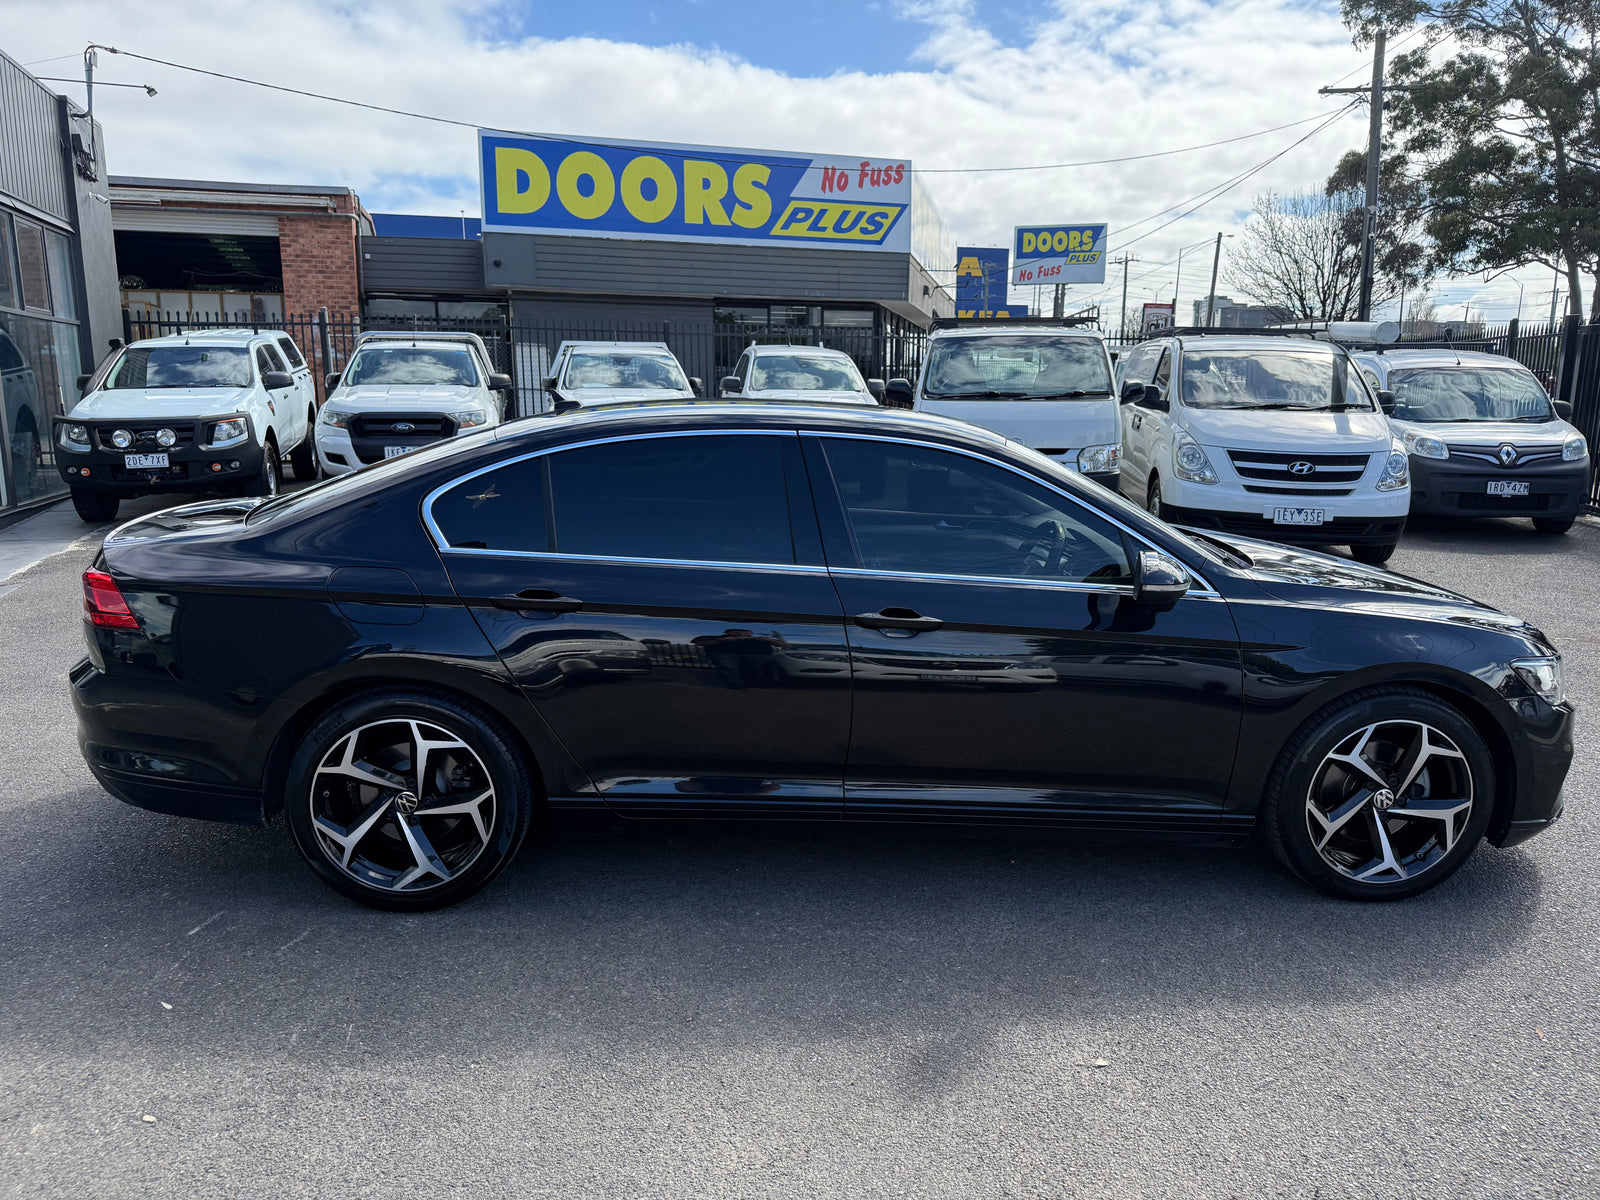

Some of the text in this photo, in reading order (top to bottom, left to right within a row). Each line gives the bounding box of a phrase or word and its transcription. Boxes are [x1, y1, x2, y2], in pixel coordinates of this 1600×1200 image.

[495, 146, 772, 229] DOORS
[821, 161, 905, 194] No Fuss
[781, 207, 889, 236] PLUS
[1022, 230, 1094, 253] DOORS
[1069, 253, 1097, 263] PLUS
[1019, 265, 1062, 282] No Fuss
[126, 455, 166, 466] 2DE 7XF
[1277, 510, 1322, 522] 1EY 3SE
